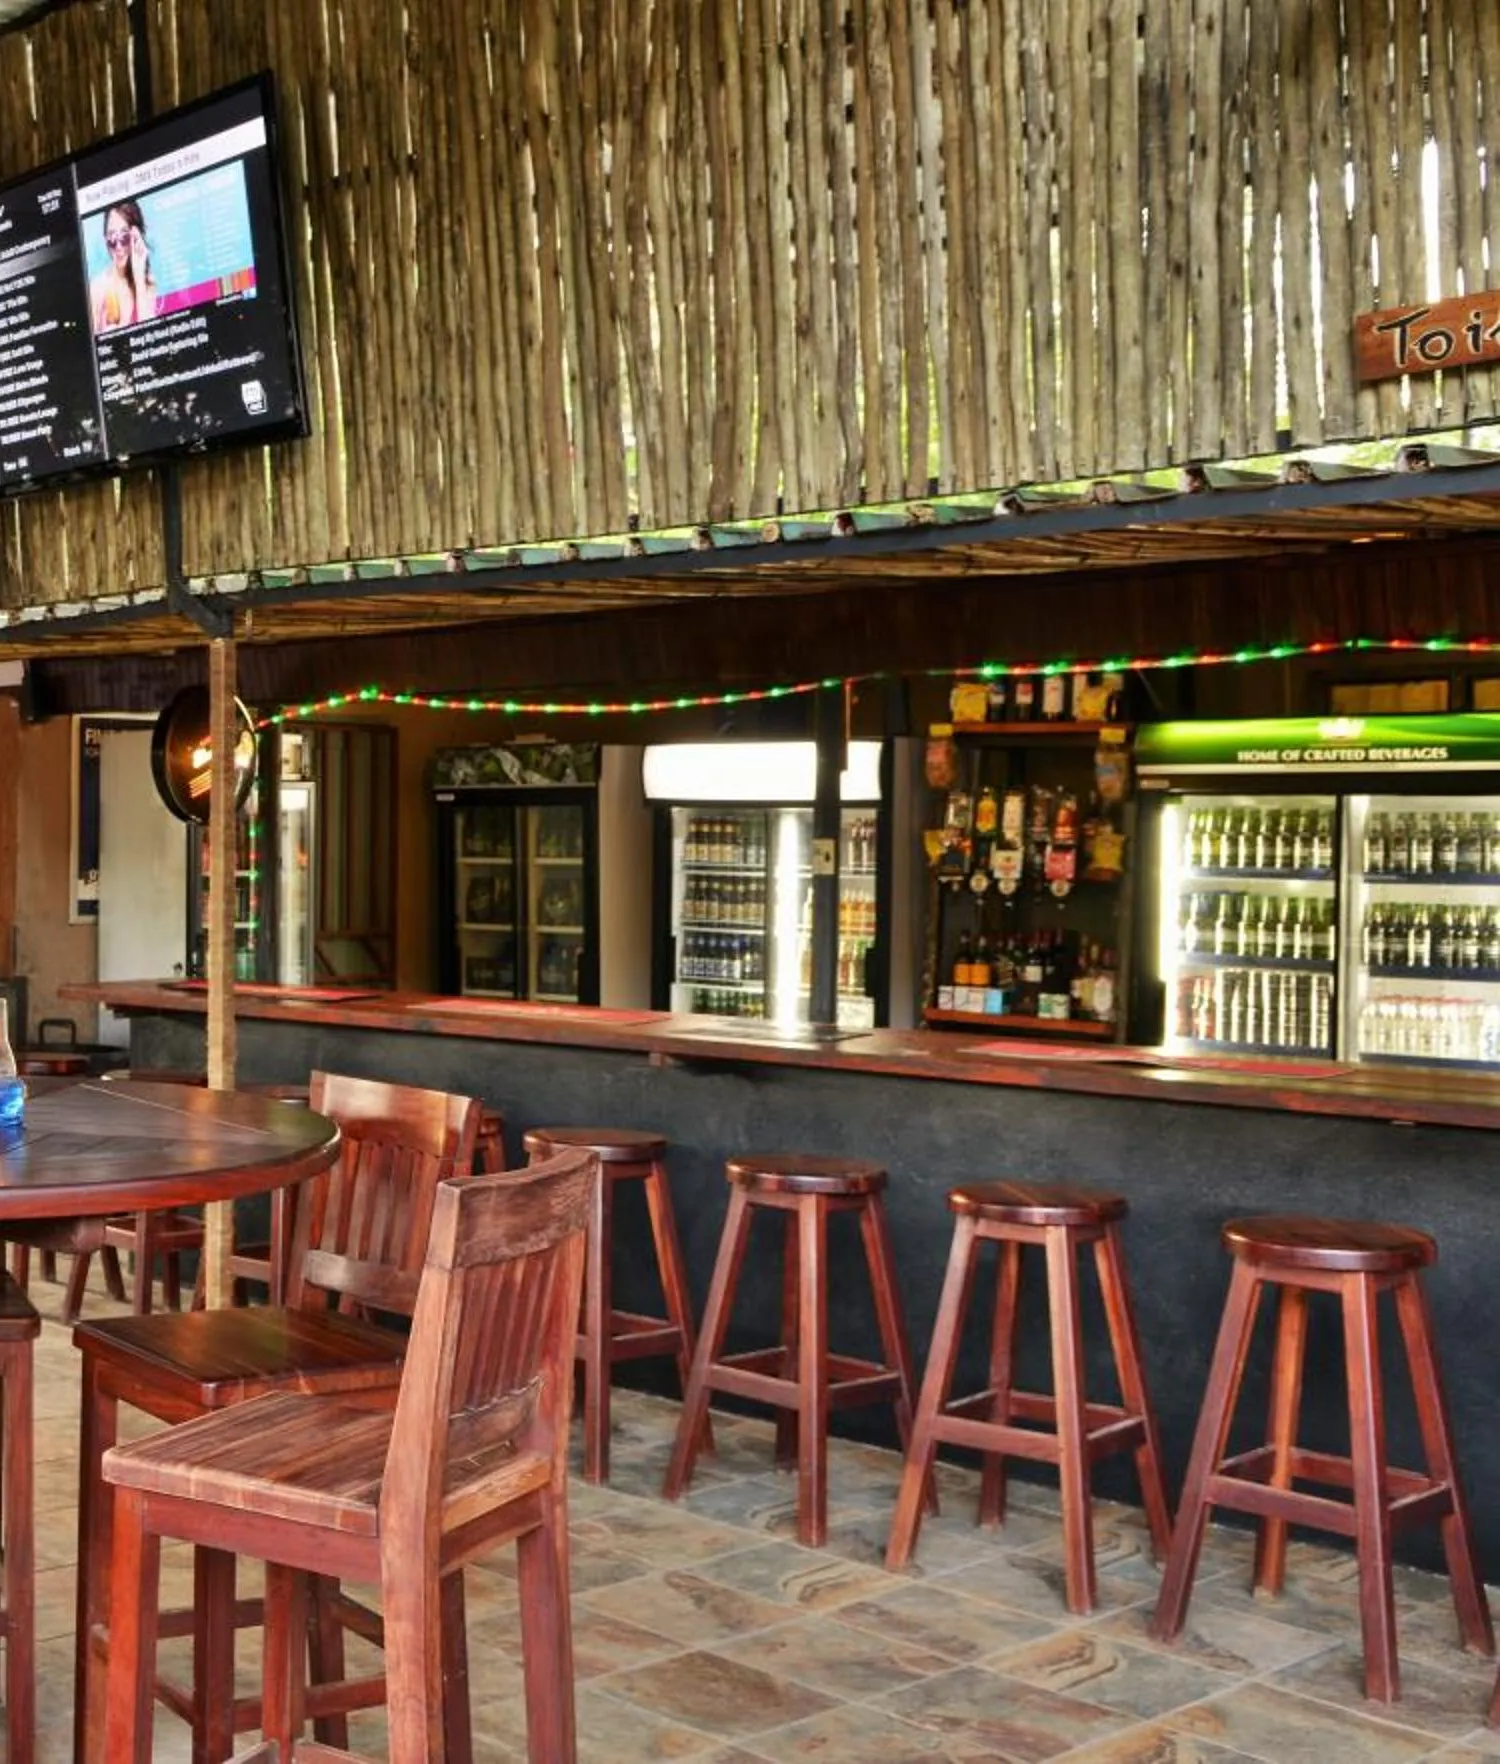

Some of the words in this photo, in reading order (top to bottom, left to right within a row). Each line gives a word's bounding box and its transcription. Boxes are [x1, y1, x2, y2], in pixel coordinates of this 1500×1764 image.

[1237, 751, 1278, 762] HOME
[1282, 750, 1300, 762] OF
[1304, 749, 1365, 761] CRAFTED
[1368, 747, 1449, 761] BEVERAGES
